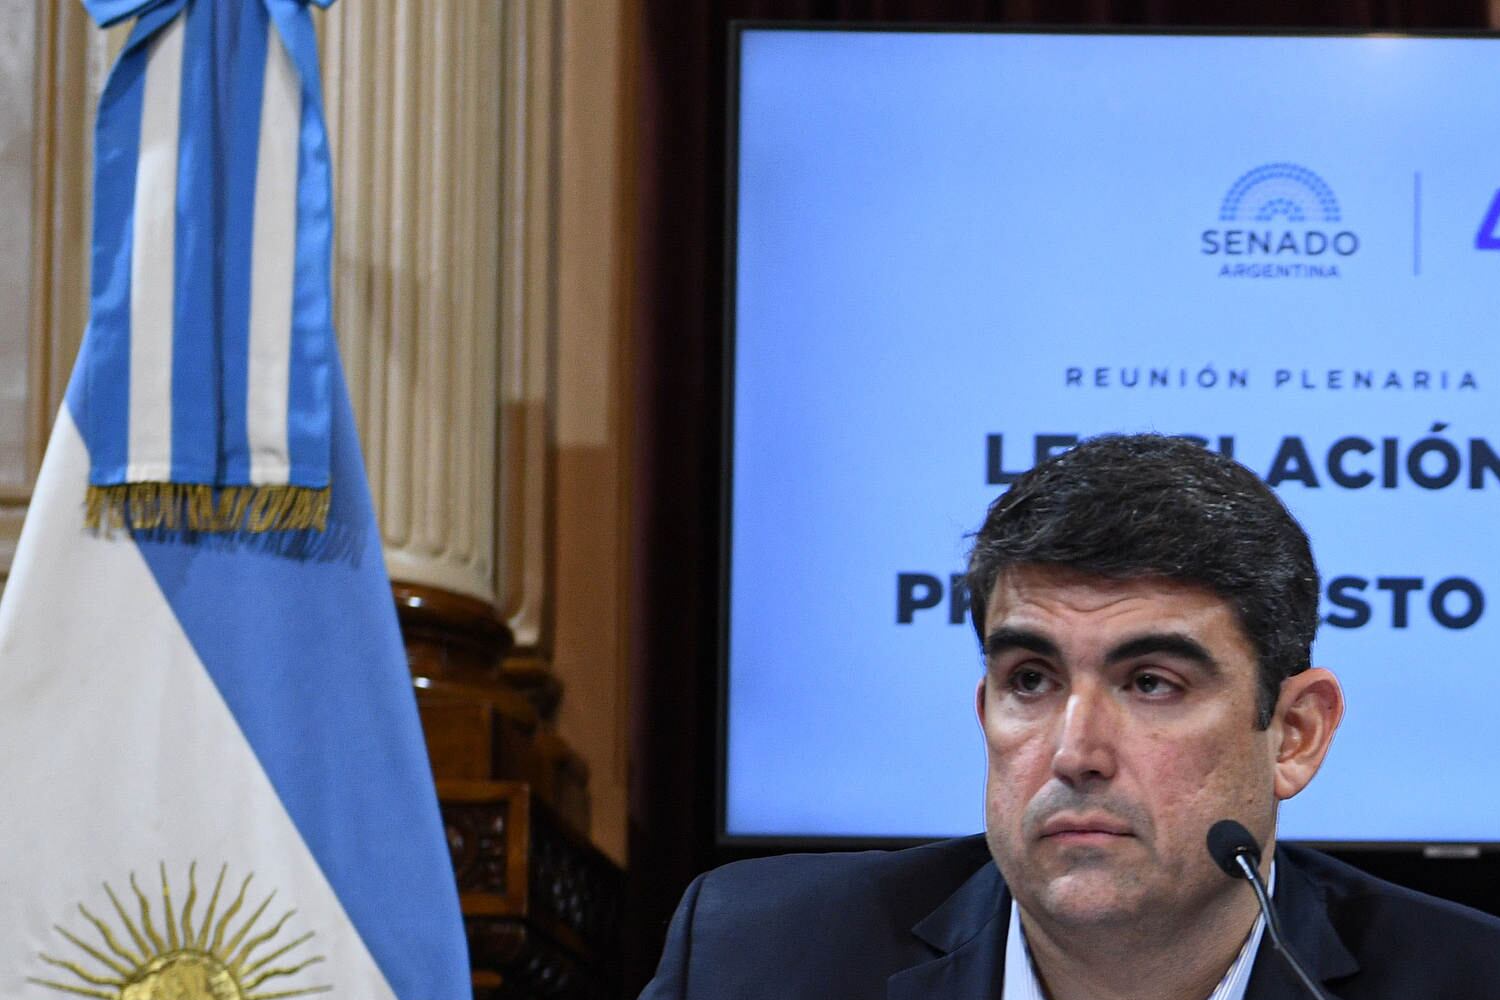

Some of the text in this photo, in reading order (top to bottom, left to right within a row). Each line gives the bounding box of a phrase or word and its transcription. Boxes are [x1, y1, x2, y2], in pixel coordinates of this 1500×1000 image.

[1201, 229, 1360, 257] SENADO
[1218, 263, 1340, 279] ARGENTINA
[1065, 365, 1248, 389] REUNIÓN
[1274, 368, 1478, 391] PLENARIA
